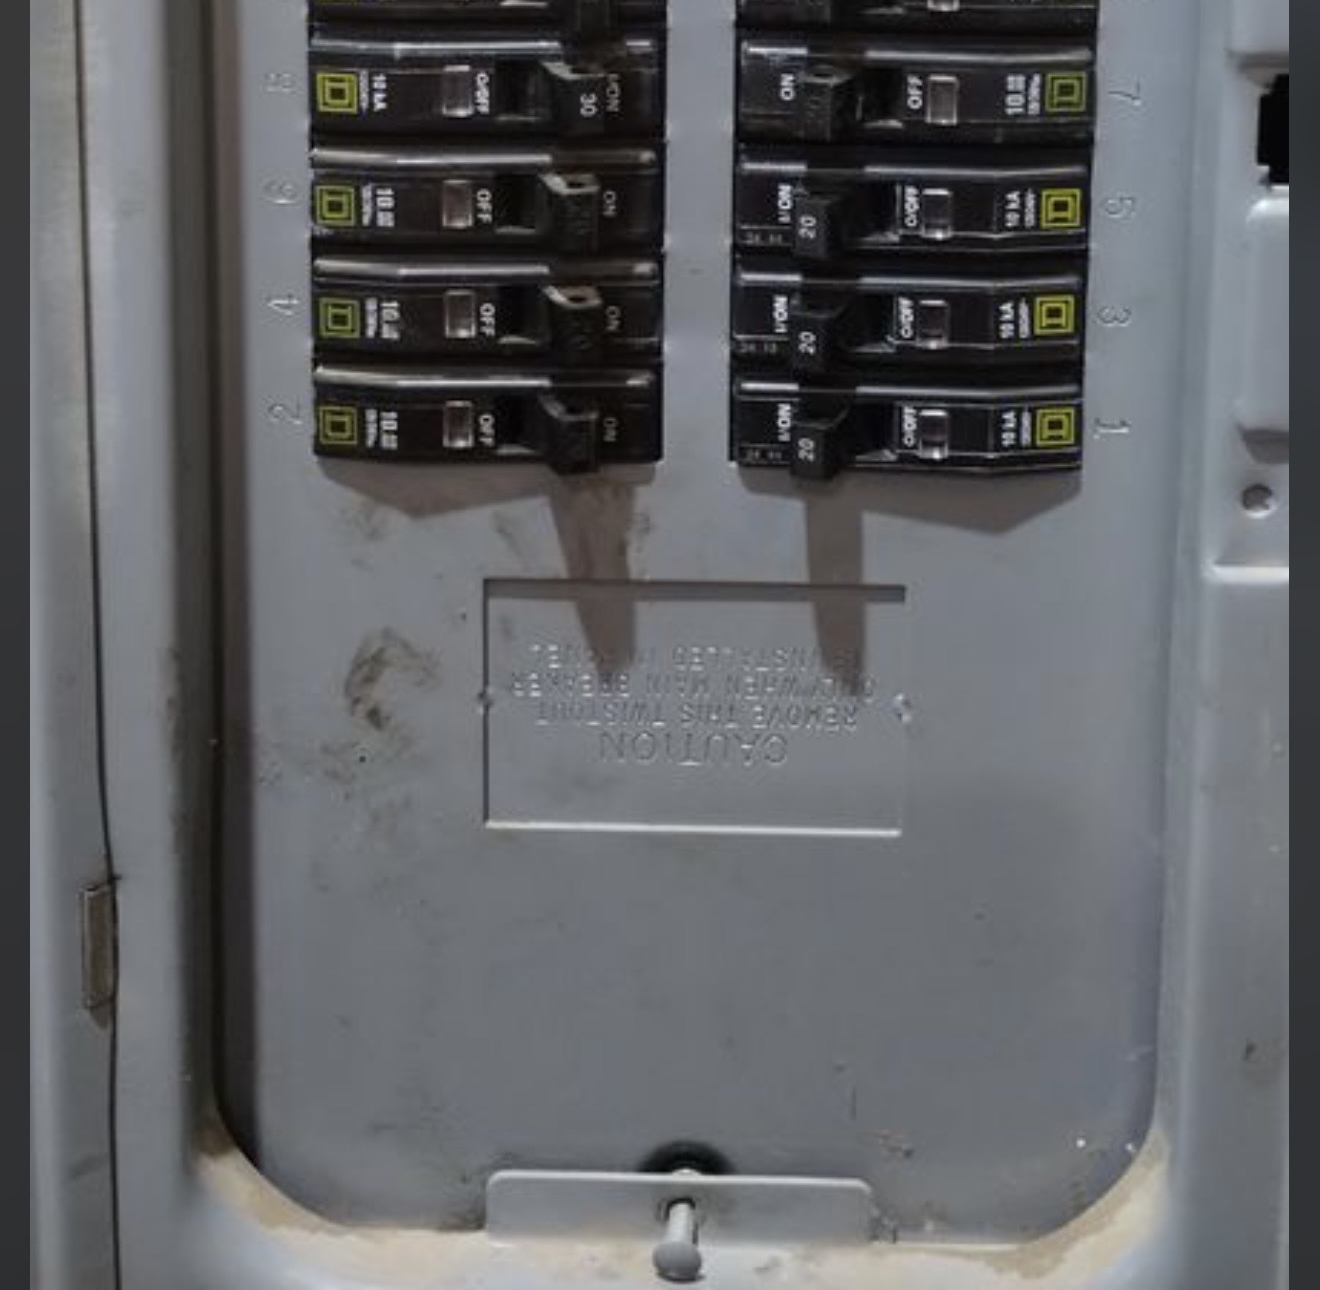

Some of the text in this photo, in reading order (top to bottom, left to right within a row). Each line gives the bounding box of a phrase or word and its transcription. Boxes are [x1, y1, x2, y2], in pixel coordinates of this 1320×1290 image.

[779, 73, 796, 102] ON
[907, 75, 924, 110] OFF
[1107, 75, 1143, 106] 7
[579, 92, 598, 118] 30
[477, 188, 492, 224] OFF
[603, 190, 617, 217] ON
[1105, 196, 1137, 221] 5
[799, 215, 817, 239] 20
[480, 303, 496, 338] OFF
[606, 305, 621, 332] ON
[1099, 307, 1132, 328] 3
[799, 331, 817, 355] 20
[479, 413, 495, 447] OFF
[798, 437, 815, 462] 20
[599, 732, 788, 767] CAUTION
